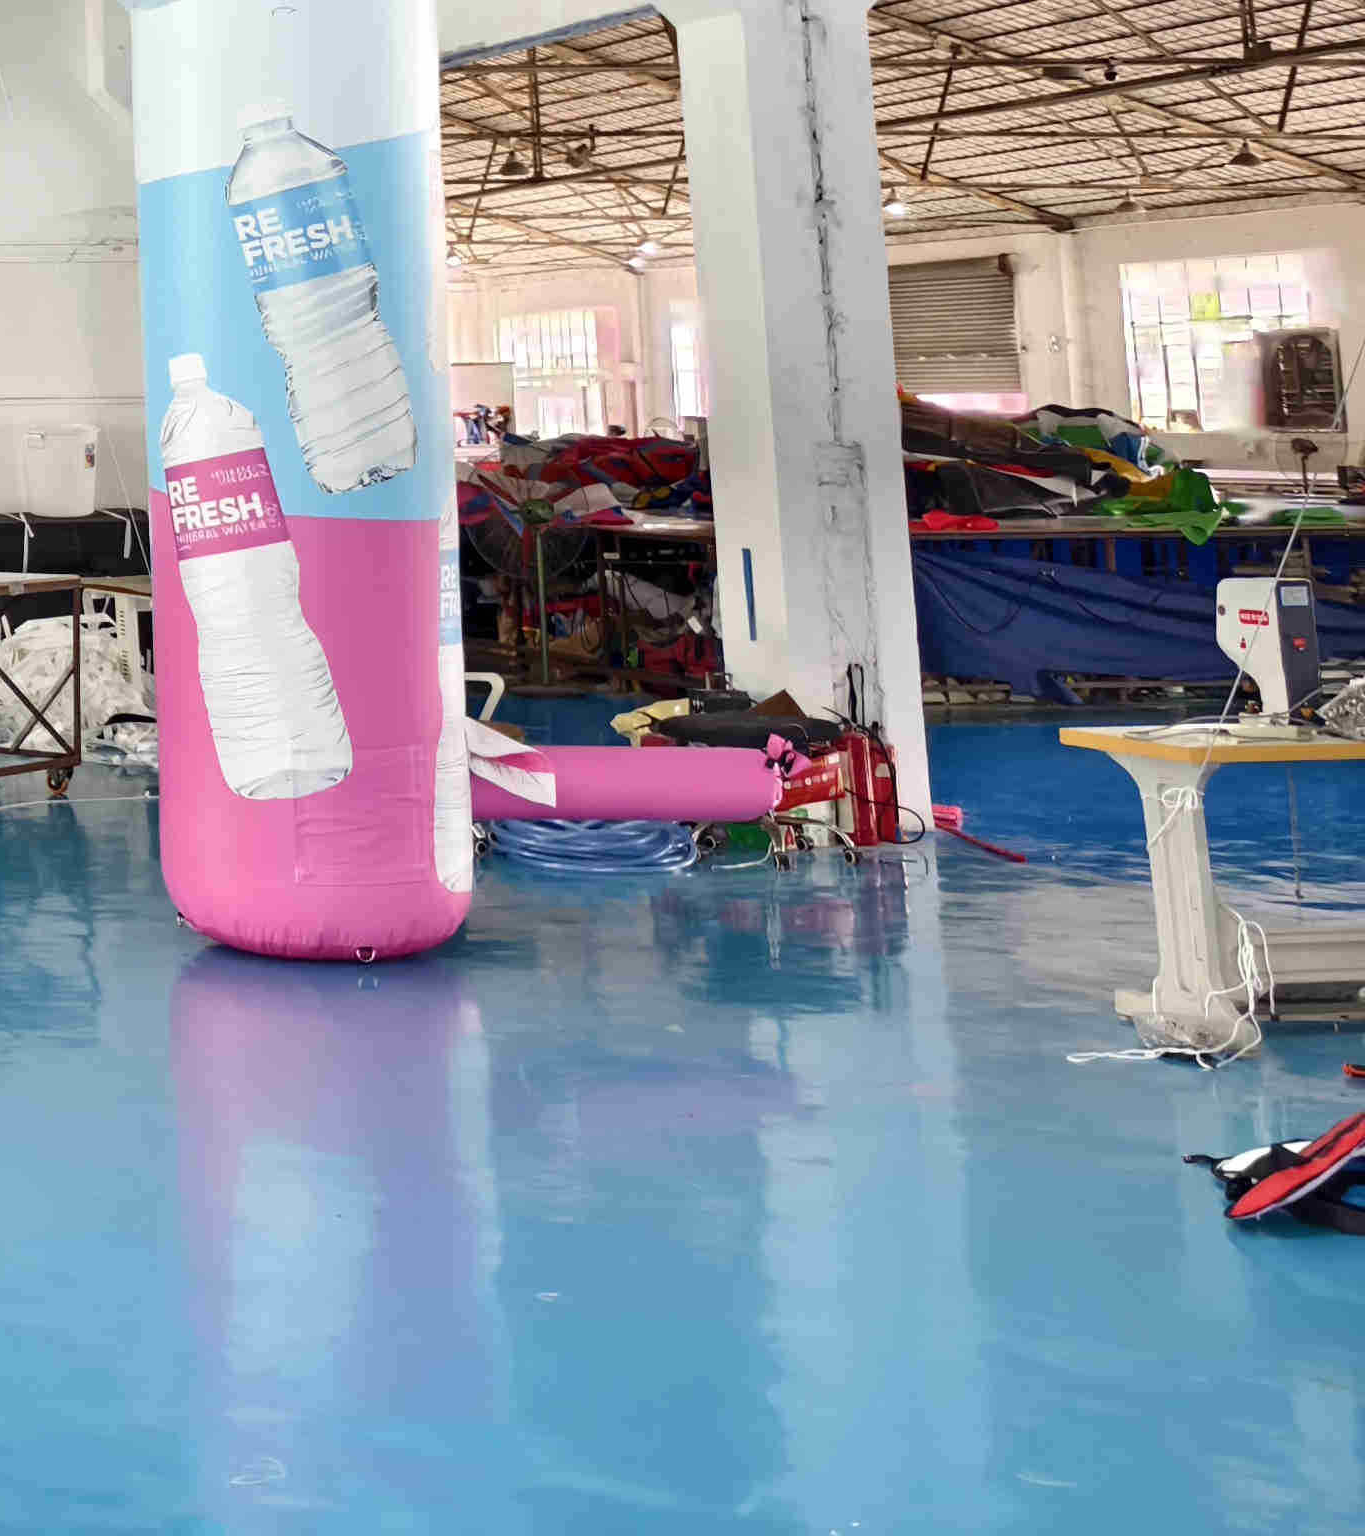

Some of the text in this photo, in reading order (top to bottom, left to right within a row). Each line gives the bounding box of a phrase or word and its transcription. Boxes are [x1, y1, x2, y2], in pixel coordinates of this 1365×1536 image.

[232, 207, 283, 241] RE
[241, 215, 355, 268] FRESH
[167, 475, 201, 507] RE
[171, 491, 264, 534] FRESH
